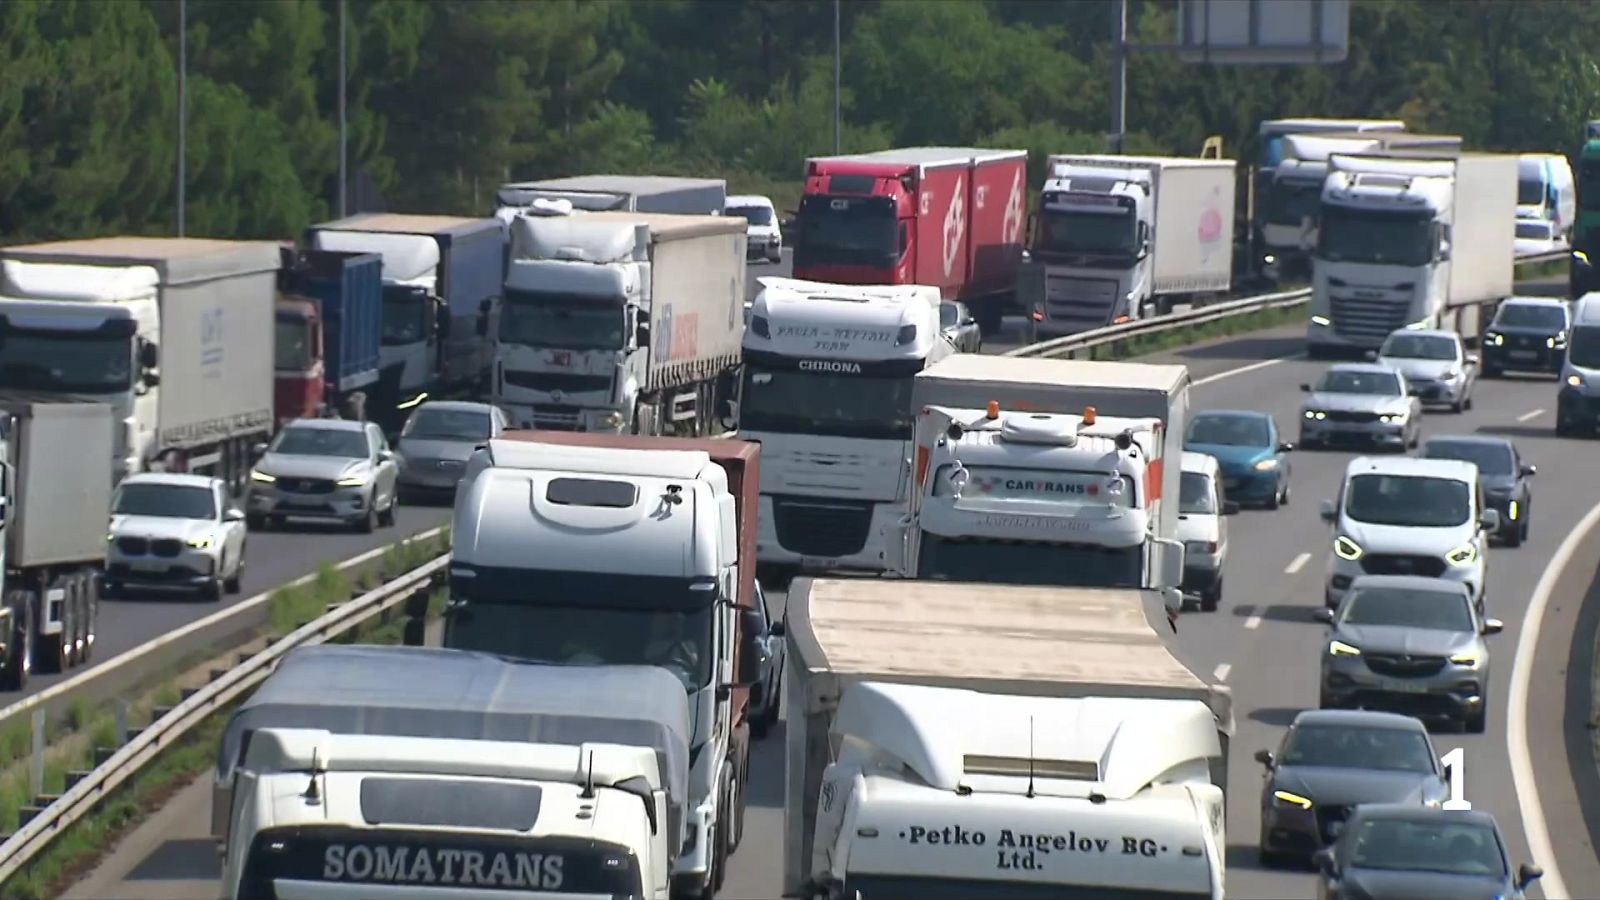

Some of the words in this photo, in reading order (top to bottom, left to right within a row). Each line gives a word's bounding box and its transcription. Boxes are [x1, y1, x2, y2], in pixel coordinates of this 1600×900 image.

[798, 360, 861, 373] CHIRONA
[997, 829, 1110, 854] Angelov
[323, 844, 564, 889] SOMATRANS
[996, 850, 1043, 869] Ltd.
